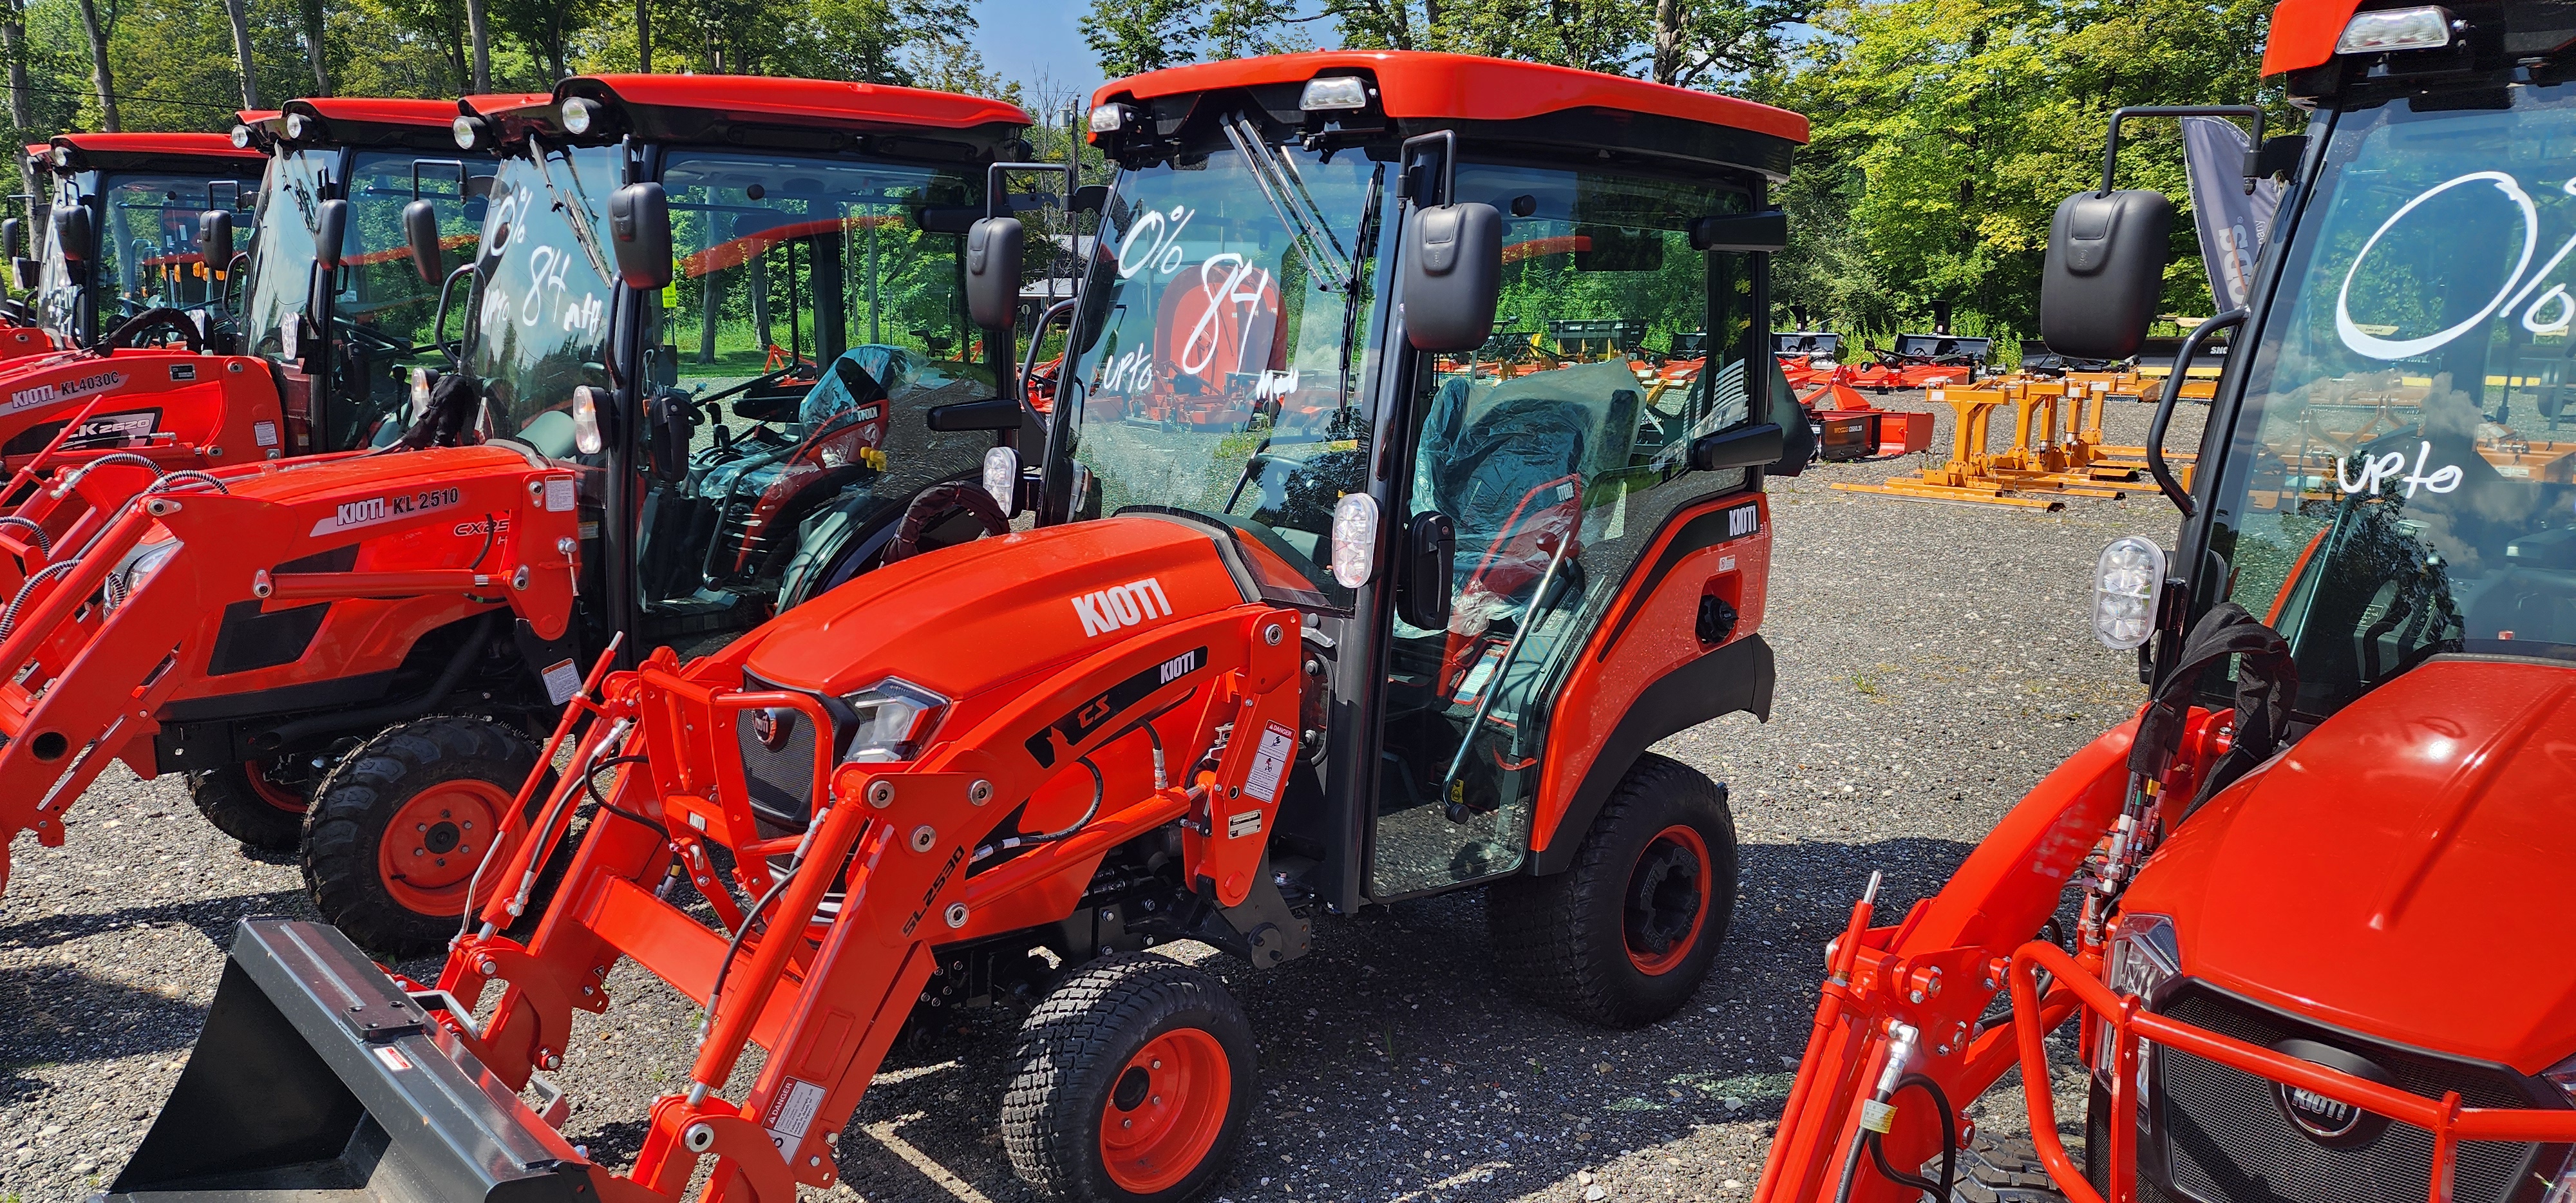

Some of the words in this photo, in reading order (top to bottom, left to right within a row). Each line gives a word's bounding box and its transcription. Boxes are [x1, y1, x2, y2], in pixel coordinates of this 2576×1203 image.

[490, 186, 533, 256] 0%
[1118, 205, 1195, 279] 0%
[522, 245, 571, 327] 84
[2219, 224, 2253, 305] ODS
[2336, 171, 2576, 360] 0%
[1182, 252, 1269, 376] 84
[11, 384, 55, 408] KIOTI
[61, 371, 119, 395] KL4030C
[337, 497, 384, 526] KIOTI
[392, 495, 415, 515] KL
[418, 486, 459, 509] 2510
[1729, 505, 1757, 537] KIOTI
[1071, 578, 1173, 637] KIOTI
[1160, 650, 1195, 684] KIOTI
[1077, 694, 1110, 728] CS
[1273, 725, 1293, 737] DANGER
[902, 844, 965, 938] SL2530
[772, 1083, 792, 1116] DANGER
[2291, 1088, 2347, 1121] KIOTI
